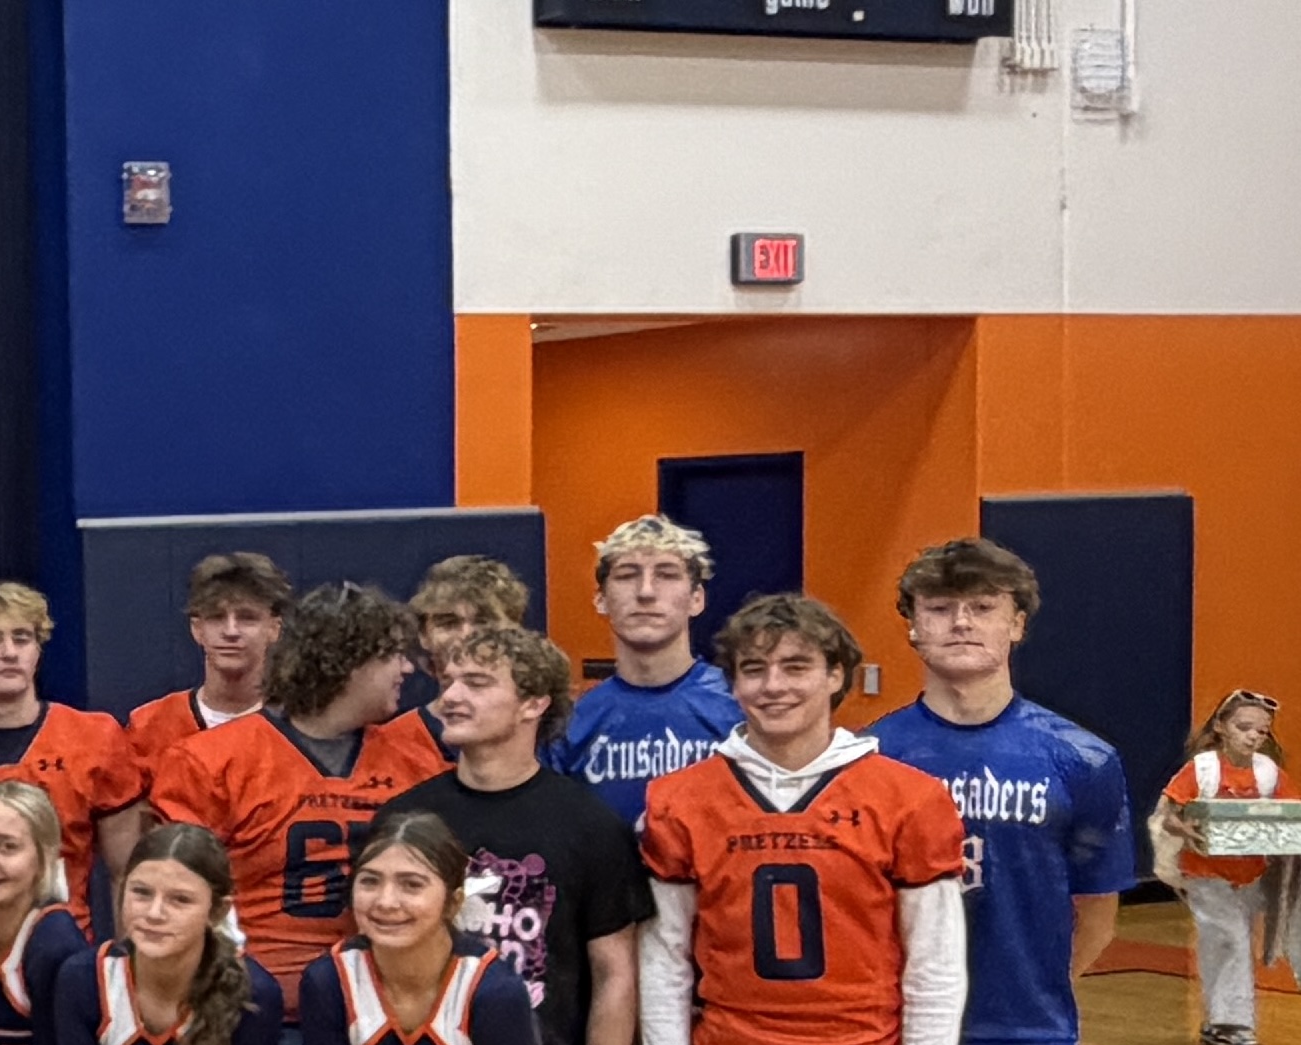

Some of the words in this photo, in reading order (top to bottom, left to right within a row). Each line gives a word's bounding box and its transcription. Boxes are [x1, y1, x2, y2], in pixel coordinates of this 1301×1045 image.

[754, 238, 797, 279] EXIT
[941, 764, 1051, 825] saders
[751, 863, 826, 980] 0
